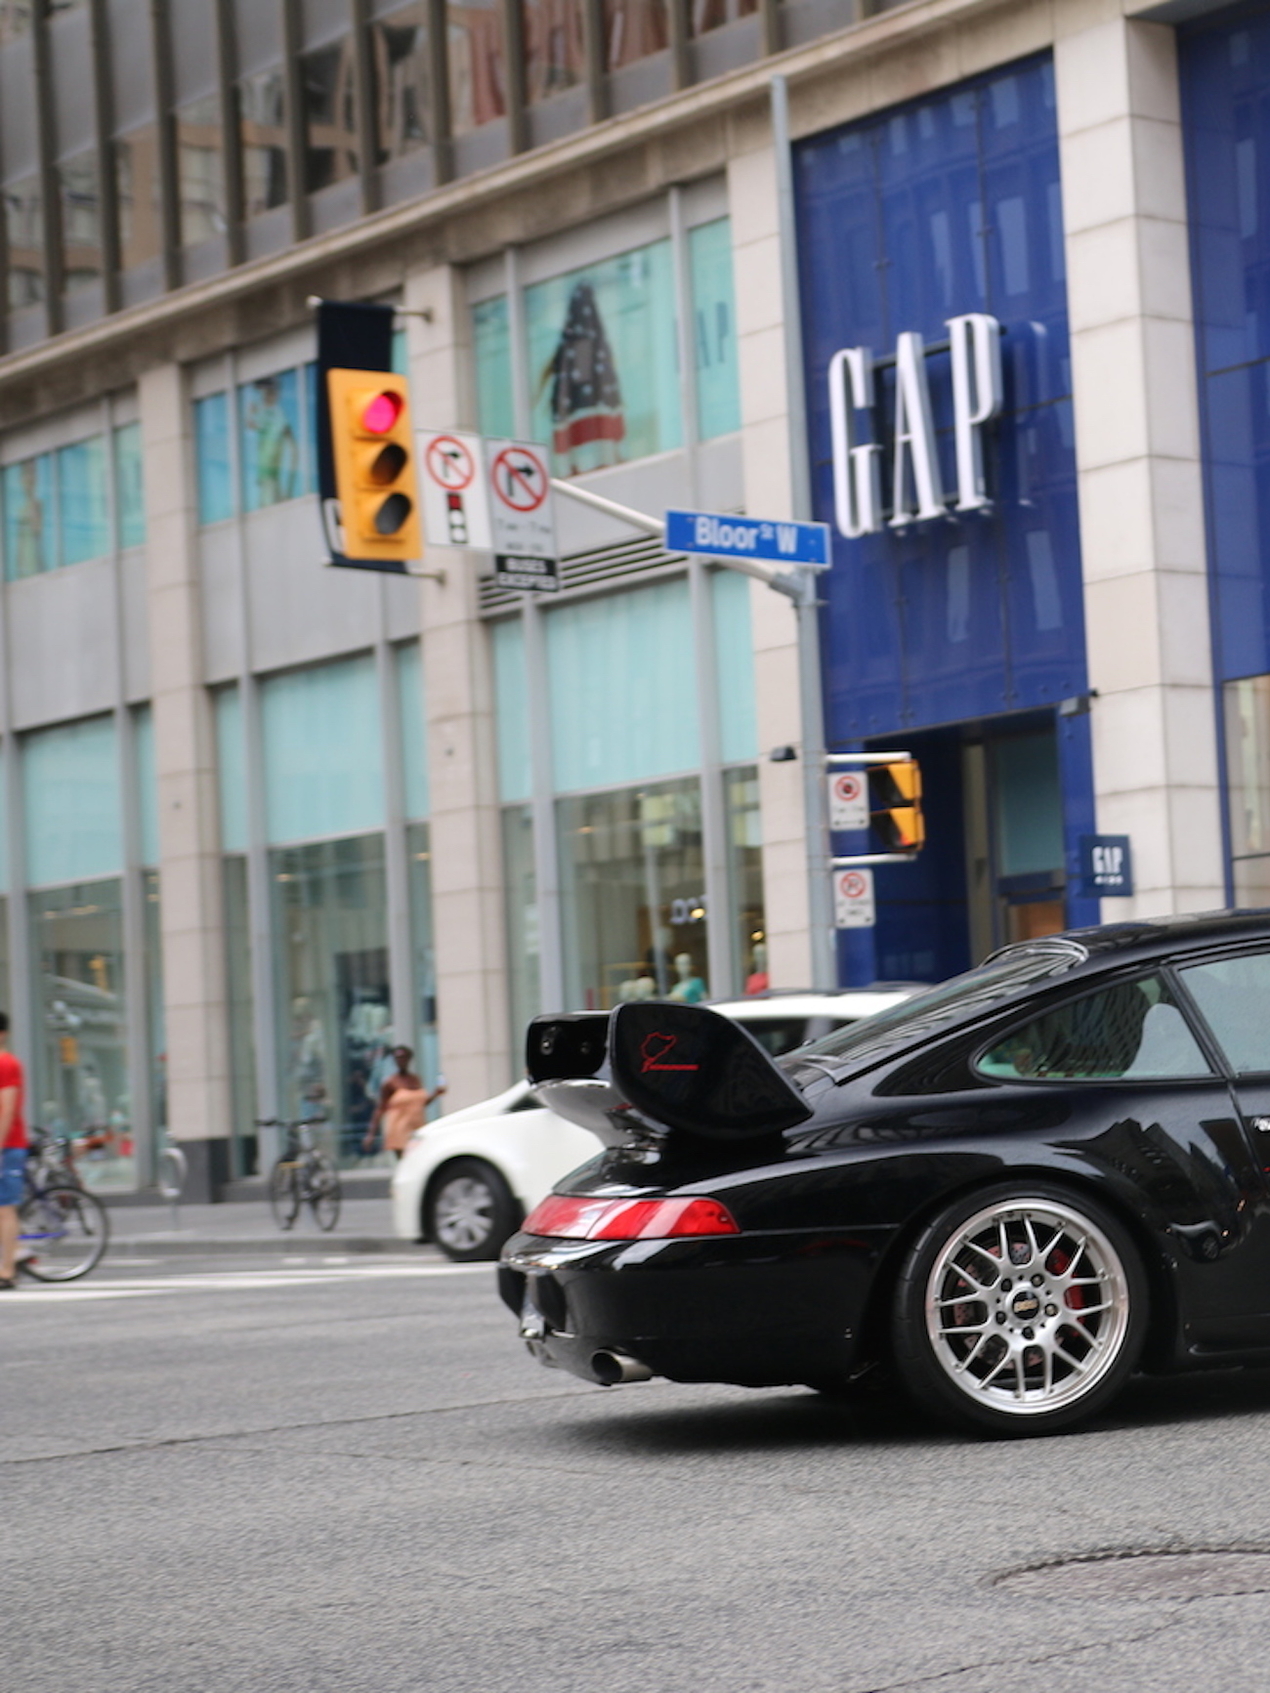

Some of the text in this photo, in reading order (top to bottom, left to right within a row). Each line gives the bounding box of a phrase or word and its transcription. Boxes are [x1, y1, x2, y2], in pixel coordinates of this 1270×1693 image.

[828, 312, 1004, 539] GAP
[695, 515, 758, 550] Bloor
[776, 524, 799, 555] W
[1092, 845, 1123, 875] GAP
